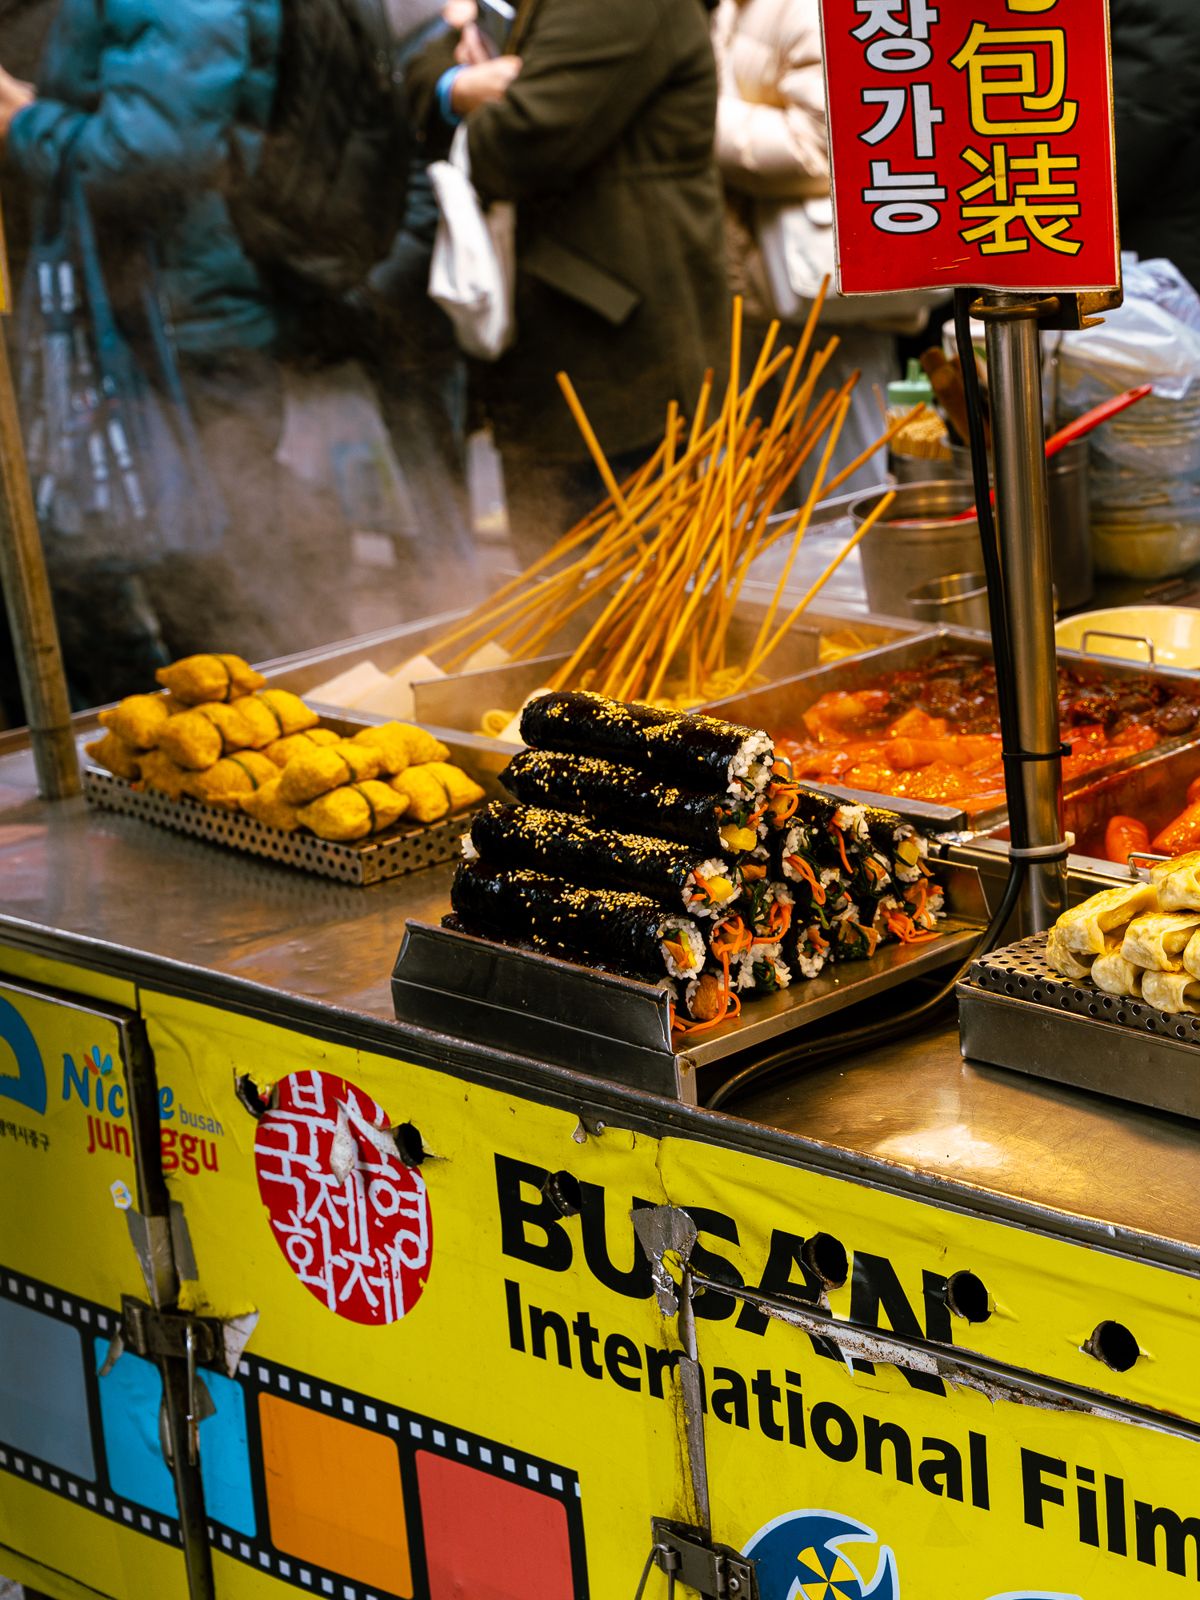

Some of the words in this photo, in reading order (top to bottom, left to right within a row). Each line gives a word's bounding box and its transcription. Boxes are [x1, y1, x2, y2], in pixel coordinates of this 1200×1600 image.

[949, 0, 1083, 256] 包装
[62, 1047, 174, 1120] Nice
[178, 1104, 225, 1137] busan
[493, 1152, 955, 1398] BUSAN
